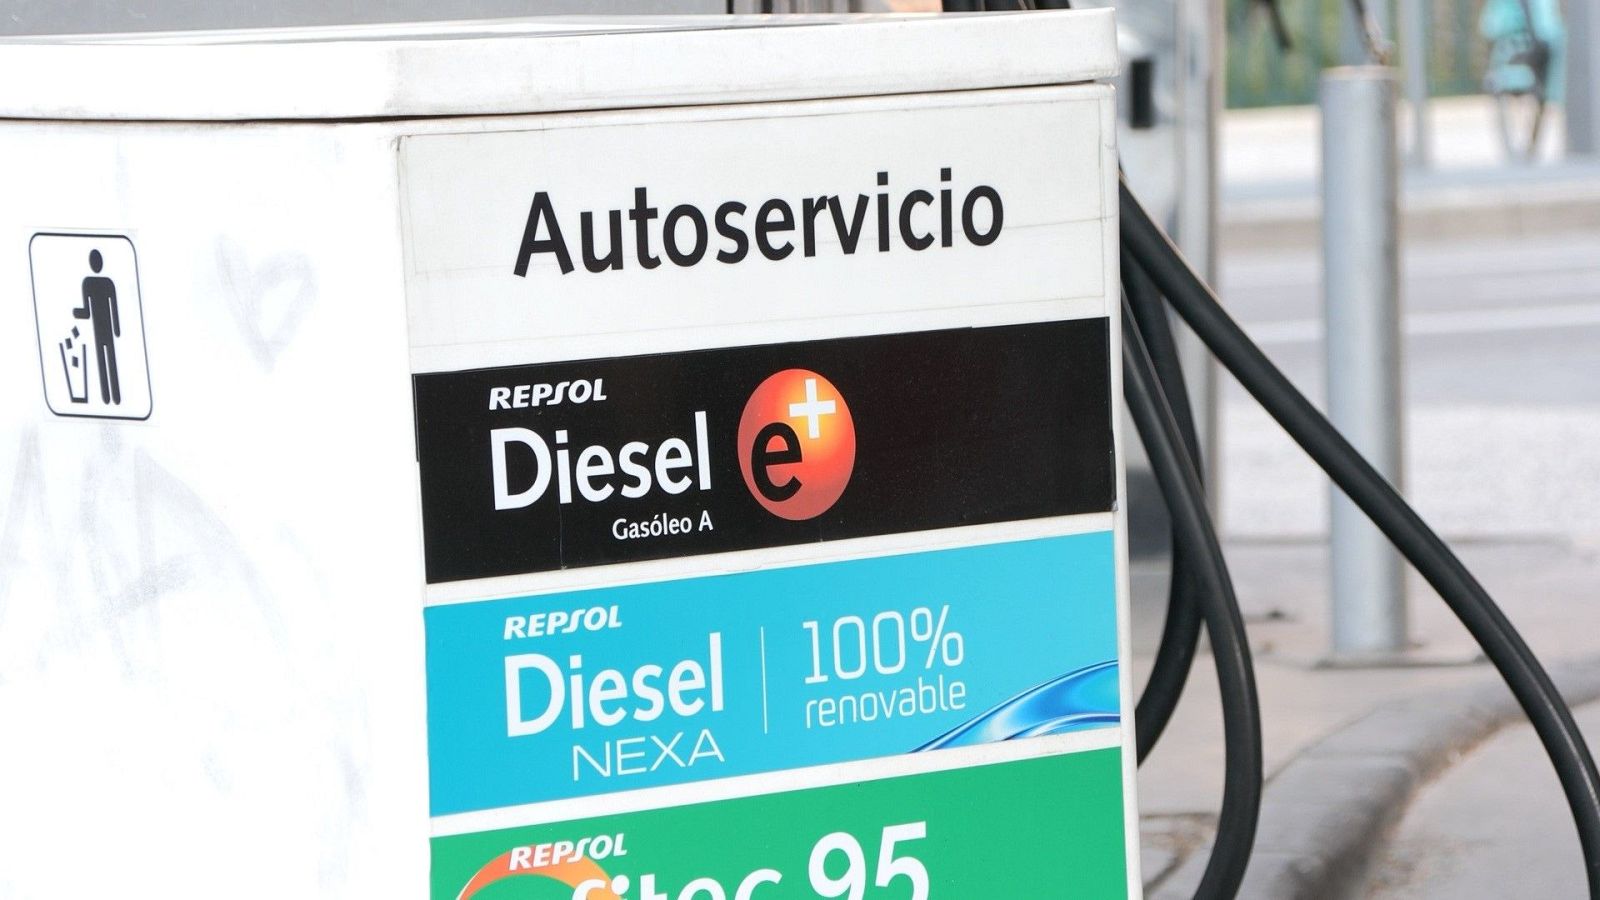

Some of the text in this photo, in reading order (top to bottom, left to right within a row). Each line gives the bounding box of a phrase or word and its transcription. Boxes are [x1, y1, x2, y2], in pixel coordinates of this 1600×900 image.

[513, 167, 1004, 278] Autoservicio
[489, 378, 607, 410] REPSOL
[490, 411, 711, 511] Diesel
[612, 510, 714, 540] Gasóleo A
[504, 605, 622, 639] REPSOL
[803, 605, 966, 685] 100%
[504, 632, 724, 738] Diesel
[805, 675, 967, 728] renovable
[572, 729, 725, 781] NEXA
[509, 833, 627, 872] REPSOL
[808, 822, 930, 900] 95
